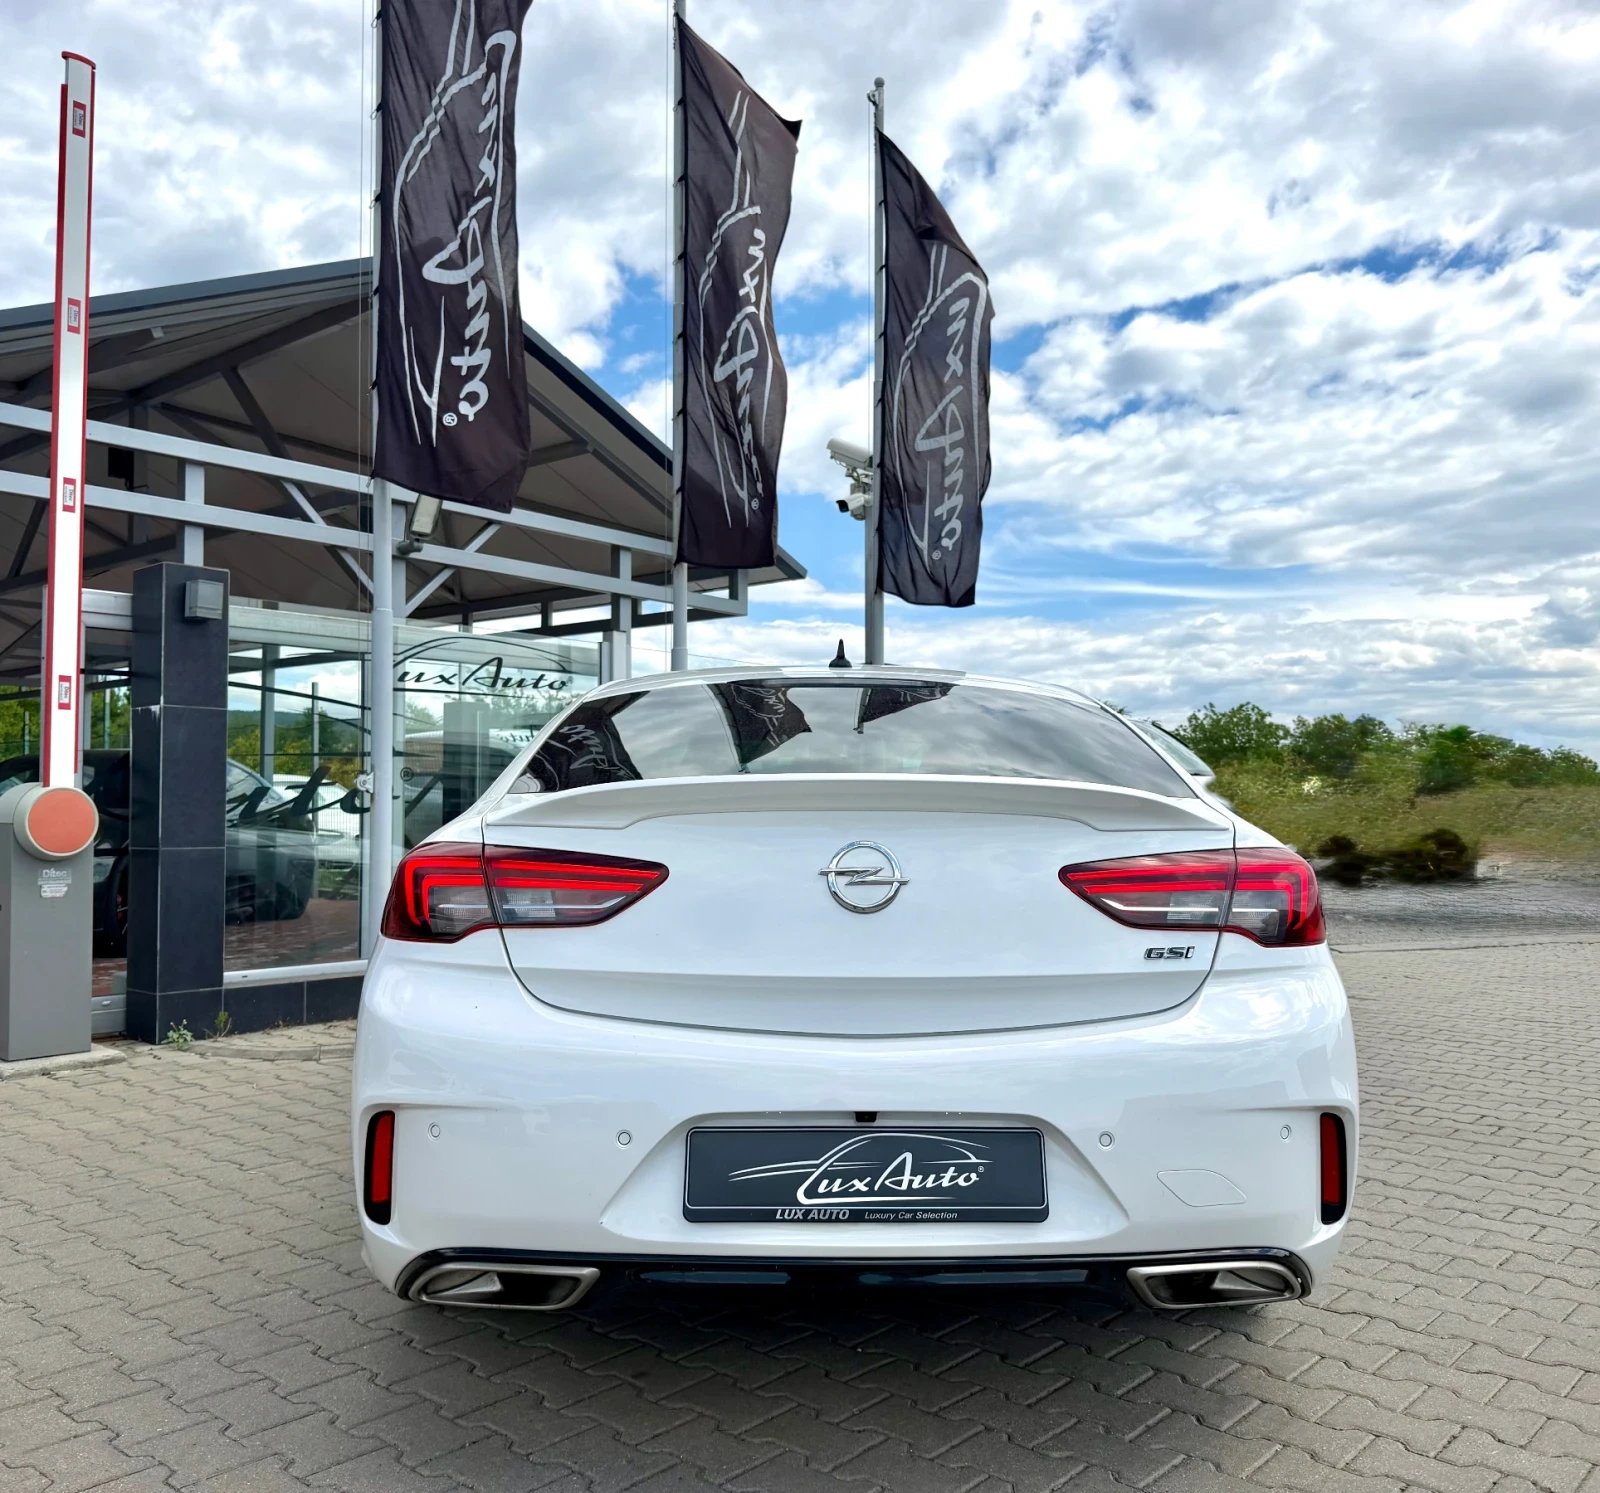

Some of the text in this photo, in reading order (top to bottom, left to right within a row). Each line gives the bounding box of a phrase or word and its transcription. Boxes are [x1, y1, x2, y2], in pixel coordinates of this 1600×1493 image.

[775, 1209, 850, 1220] LUX AUTO
[864, 1211, 958, 1220] Luxury Car Selection
